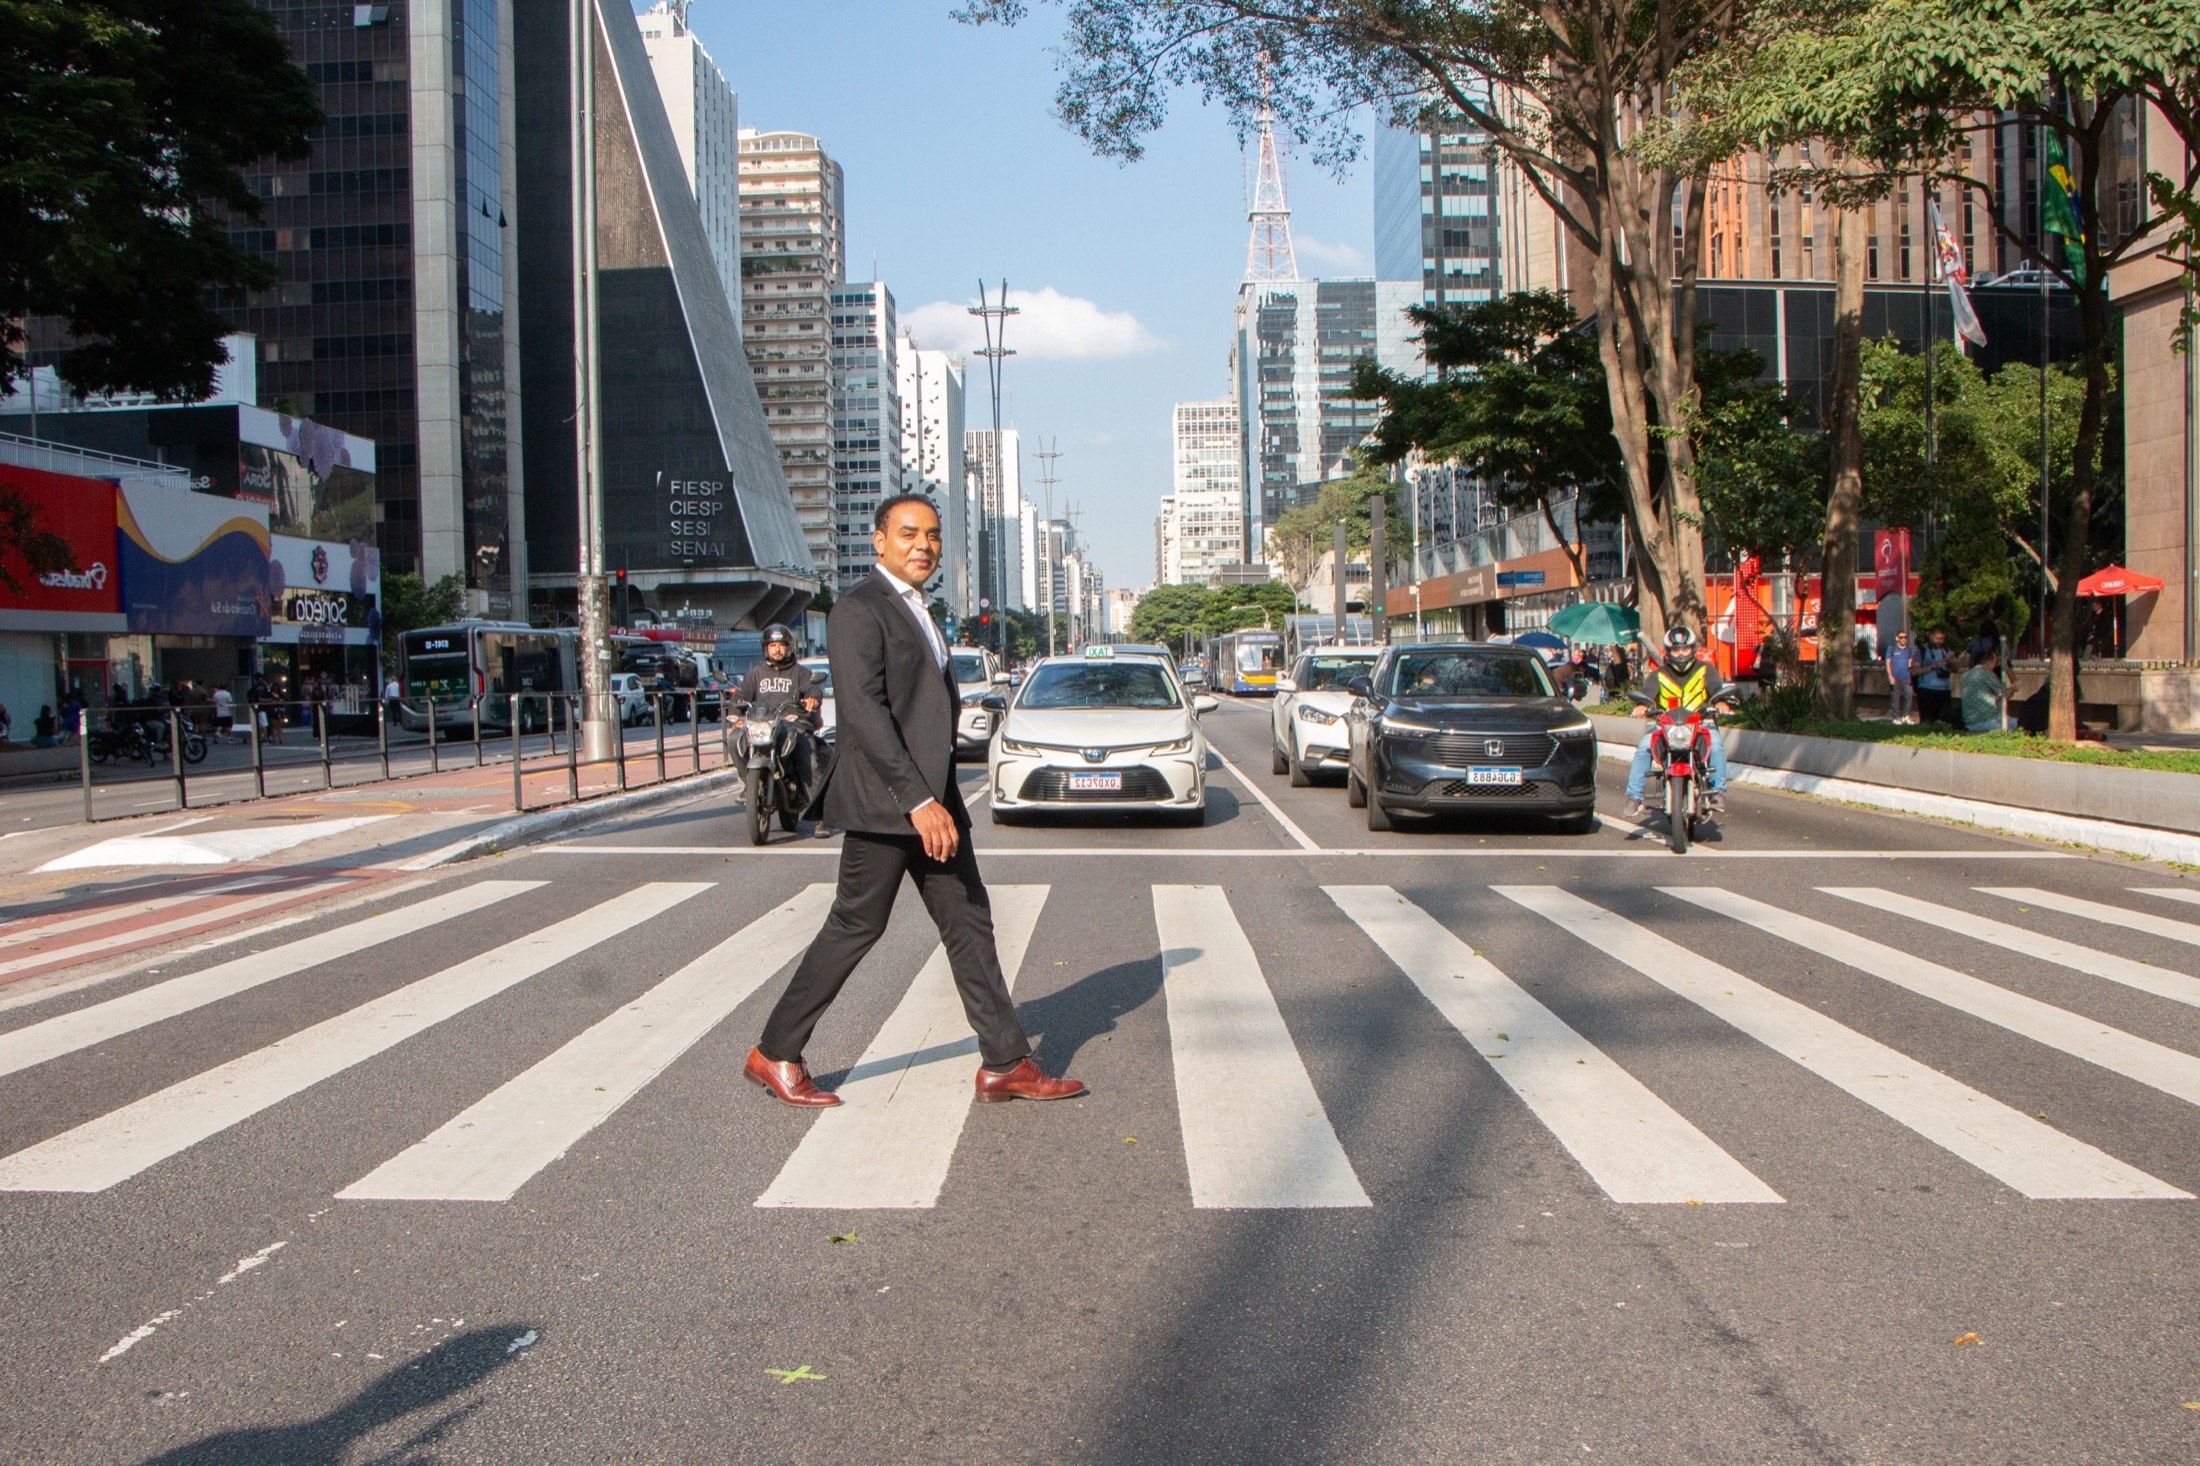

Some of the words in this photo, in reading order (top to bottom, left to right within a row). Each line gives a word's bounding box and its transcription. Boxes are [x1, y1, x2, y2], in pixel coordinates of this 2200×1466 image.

[670, 480, 723, 496] FIESP
[669, 500, 723, 516] CIESP
[670, 520, 711, 536] SESI
[671, 540, 725, 557] SENAI
